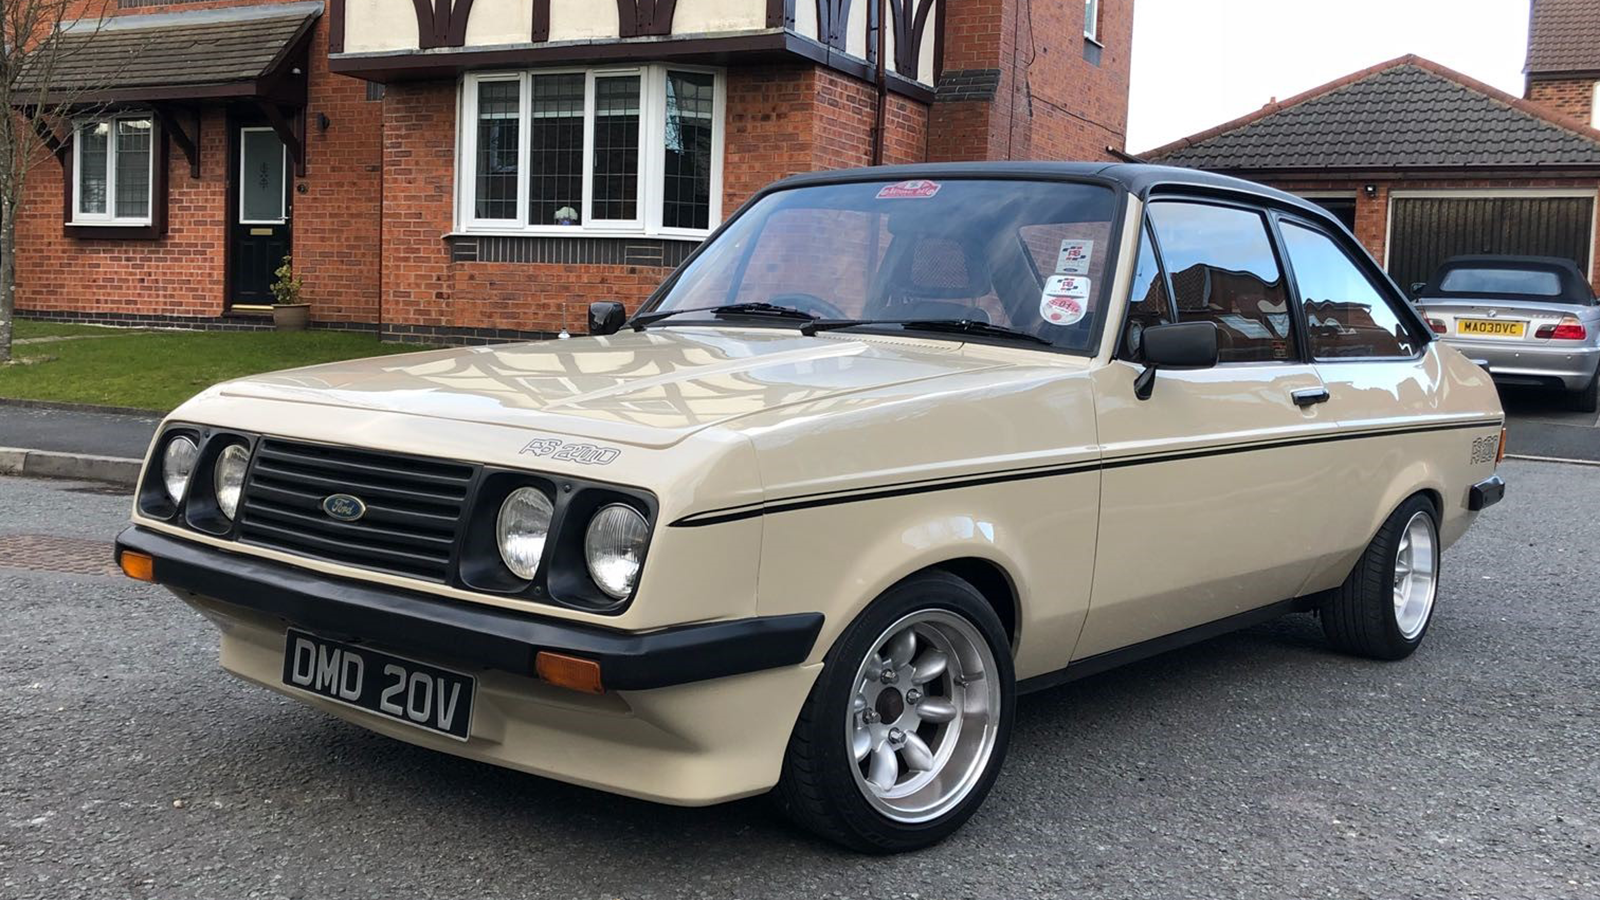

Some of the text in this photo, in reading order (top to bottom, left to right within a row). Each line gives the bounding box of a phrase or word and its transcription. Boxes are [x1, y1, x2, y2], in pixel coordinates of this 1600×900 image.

[1464, 322, 1517, 334] MA03DVC
[331, 498, 355, 515] Ford
[292, 637, 461, 731] DMD 20V
